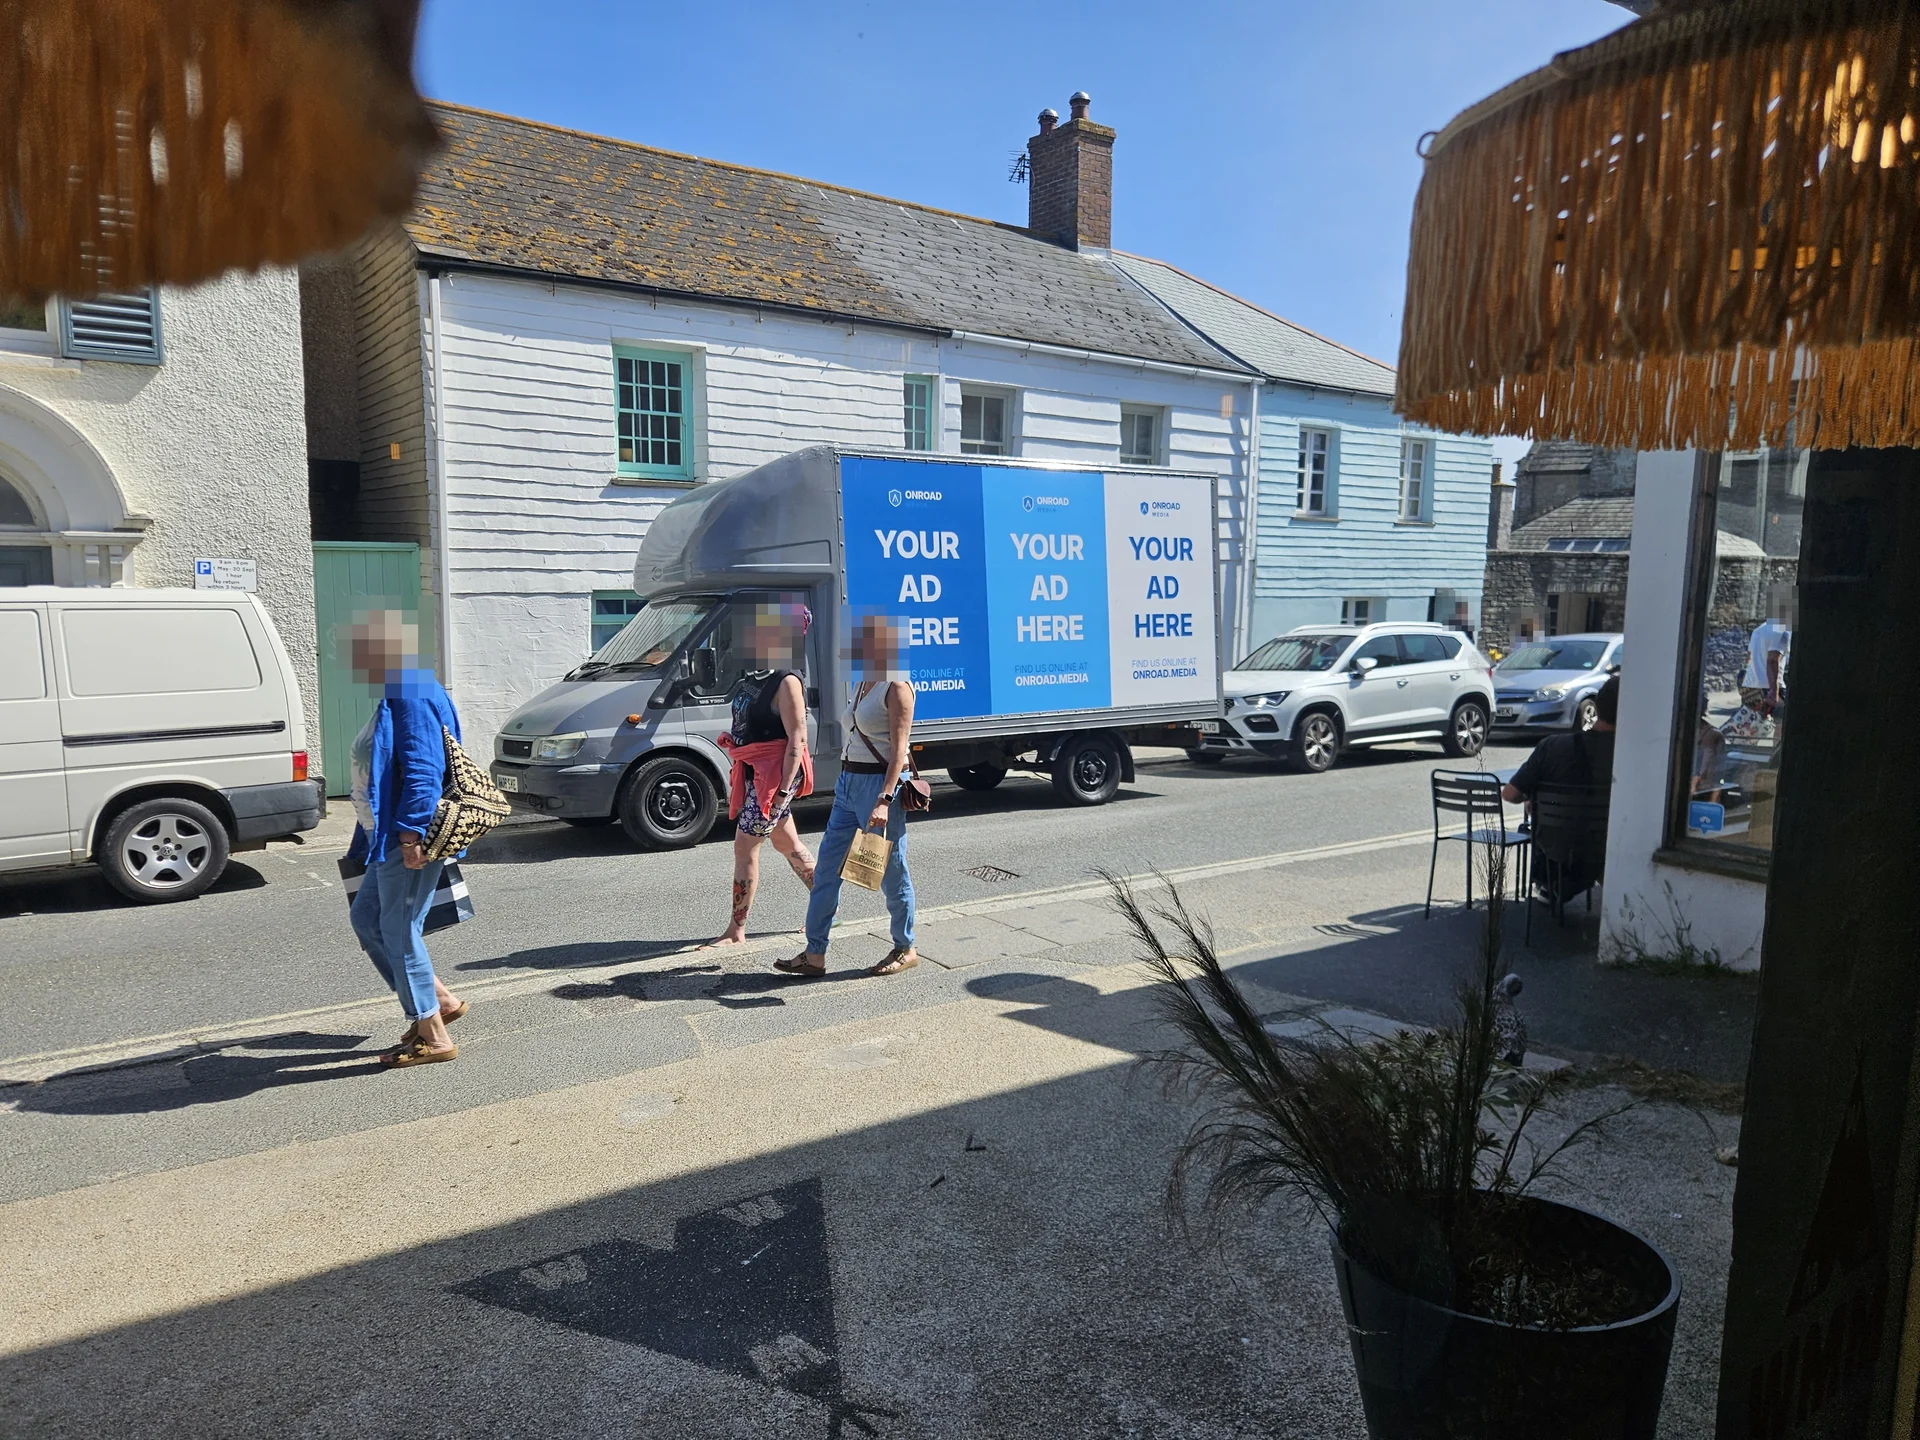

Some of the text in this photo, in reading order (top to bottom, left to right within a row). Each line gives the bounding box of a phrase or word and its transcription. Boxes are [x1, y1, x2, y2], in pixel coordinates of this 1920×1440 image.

[905, 490, 942, 500] ONROAD
[1036, 496, 1069, 506] ONROAD
[1152, 502, 1180, 510] ONROAD
[874, 530, 960, 559] YOUR
[1010, 533, 1084, 560] YOUR
[1128, 536, 1194, 561] YOUR
[898, 574, 942, 602] AD
[1030, 575, 1068, 601] AD
[1146, 576, 1179, 599] AD
[909, 617, 960, 646] ERE
[1017, 615, 1084, 642] HERE
[1135, 614, 1193, 638] HERE
[1014, 662, 1088, 674] FIND US ONLINE AT
[1150, 659, 1160, 667] US
[1162, 658, 1187, 666] ONLINE
[920, 668, 952, 679] ONLINE
[954, 667, 964, 677] AT
[1015, 673, 1089, 686] ONROAD.MEDIA
[1133, 668, 1197, 680] ONROAD.MEDIA
[914, 679, 966, 692] AD.MEDIA
[858, 846, 884, 862] Holland
[859, 855, 882, 870] Barrett
